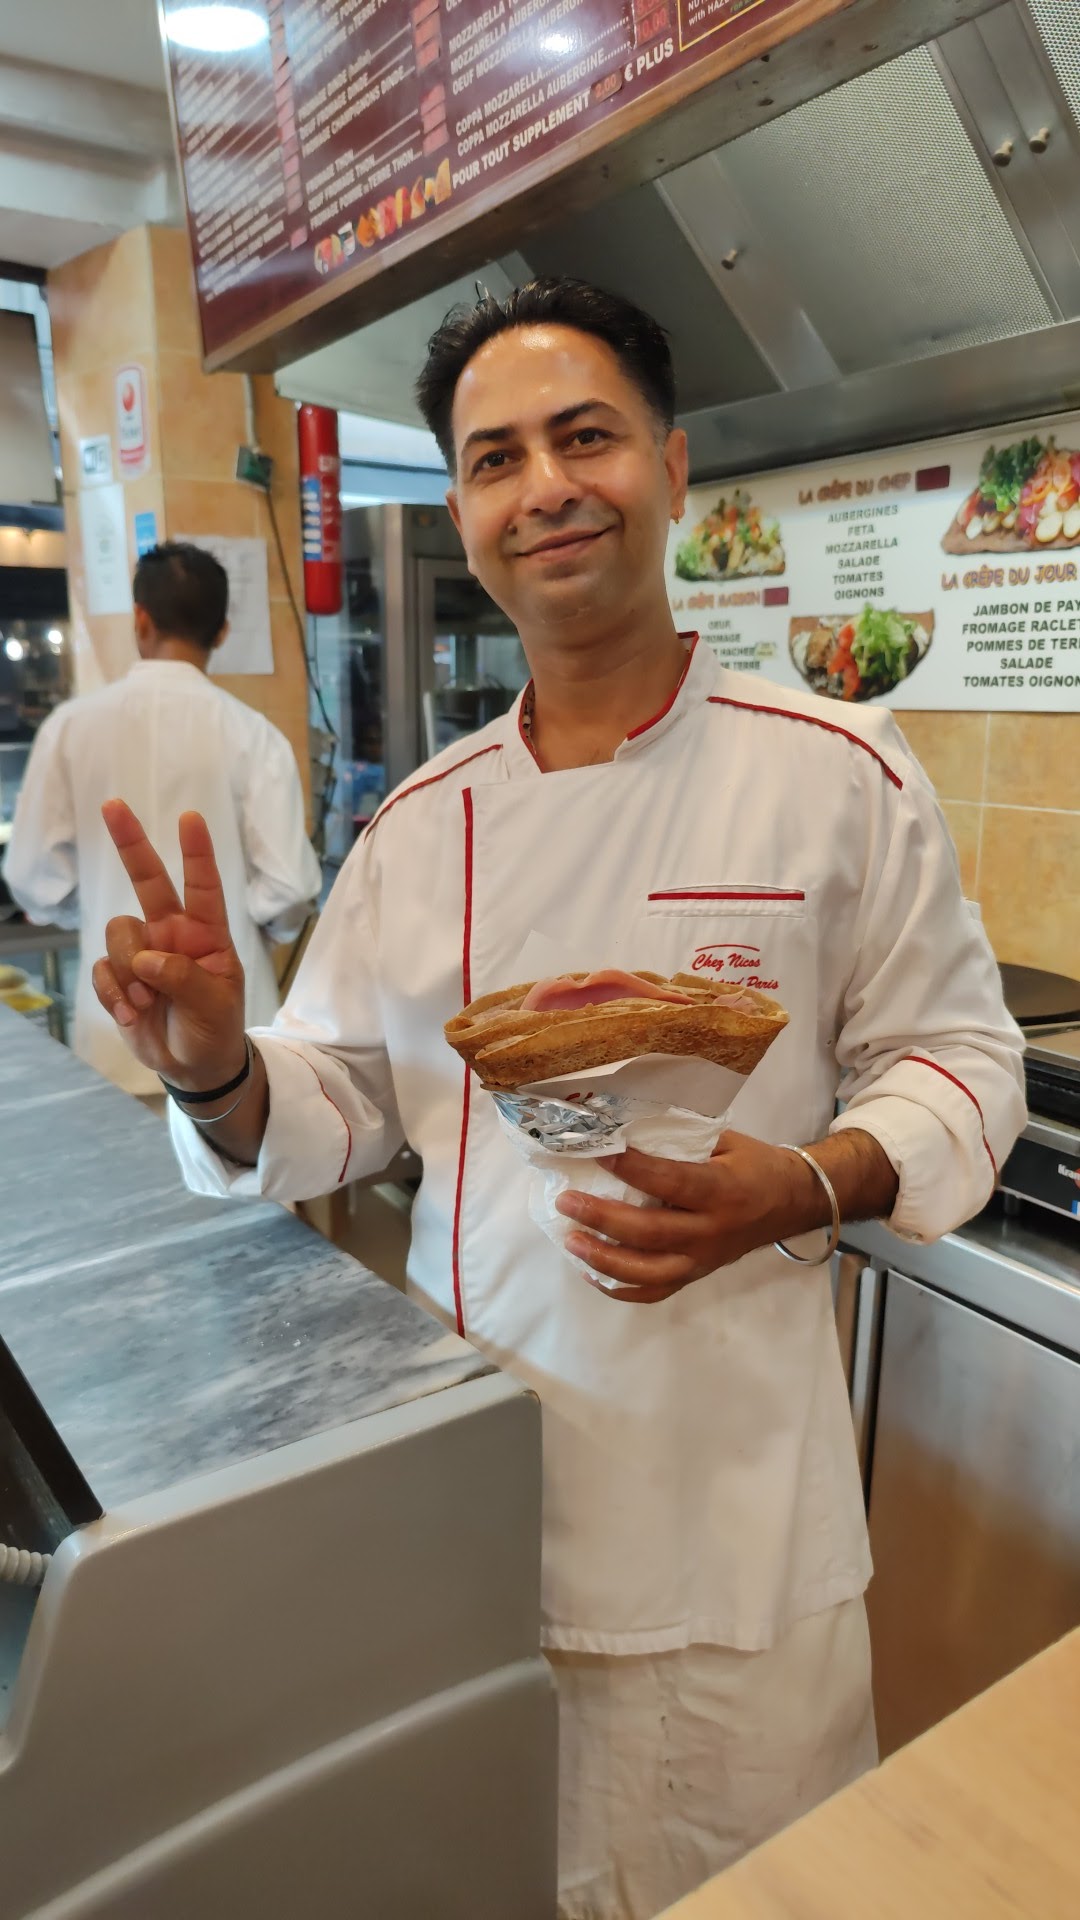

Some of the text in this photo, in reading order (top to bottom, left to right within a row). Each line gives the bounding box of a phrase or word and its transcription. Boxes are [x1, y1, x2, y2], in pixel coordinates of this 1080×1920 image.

[449, 1, 505, 55] MOZZARELLA
[450, 22, 507, 75] MOZZARELLA
[452, 68, 475, 95] OEUF
[455, 67, 544, 137] COPPA MOZZARELLA
[457, 47, 605, 157] COPPA MOZZARELLA AUBERGINE
[452, 160, 481, 190] POUR
[481, 139, 510, 172] TOUT
[512, 86, 592, 153] SUPPLEMENT
[624, 62, 634, 82] €
[636, 37, 675, 76] PLUS
[798, 489, 814, 505] LA
[855, 478, 875, 497] DU
[827, 504, 899, 524] AUBERGINES
[847, 523, 875, 537] FETA
[824, 537, 899, 555] MOZZARELLA
[837, 555, 880, 569] SALADE
[832, 571, 883, 585] TOMATES
[941, 572, 959, 591] LA
[1008, 566, 1030, 586] DU
[1034, 562, 1077, 584] JOUR
[833, 587, 885, 601] OIGNONS
[973, 602, 1029, 617] JAMBON
[1033, 601, 1052, 613] DE
[962, 621, 1026, 635] FROMAGE
[966, 637, 1080, 653] POMMES DE TER
[1000, 657, 1053, 669] SALADE
[963, 676, 1024, 688] TOMATES
[692, 953, 761, 972] Chez Nicos
[746, 976, 779, 989] Paris
